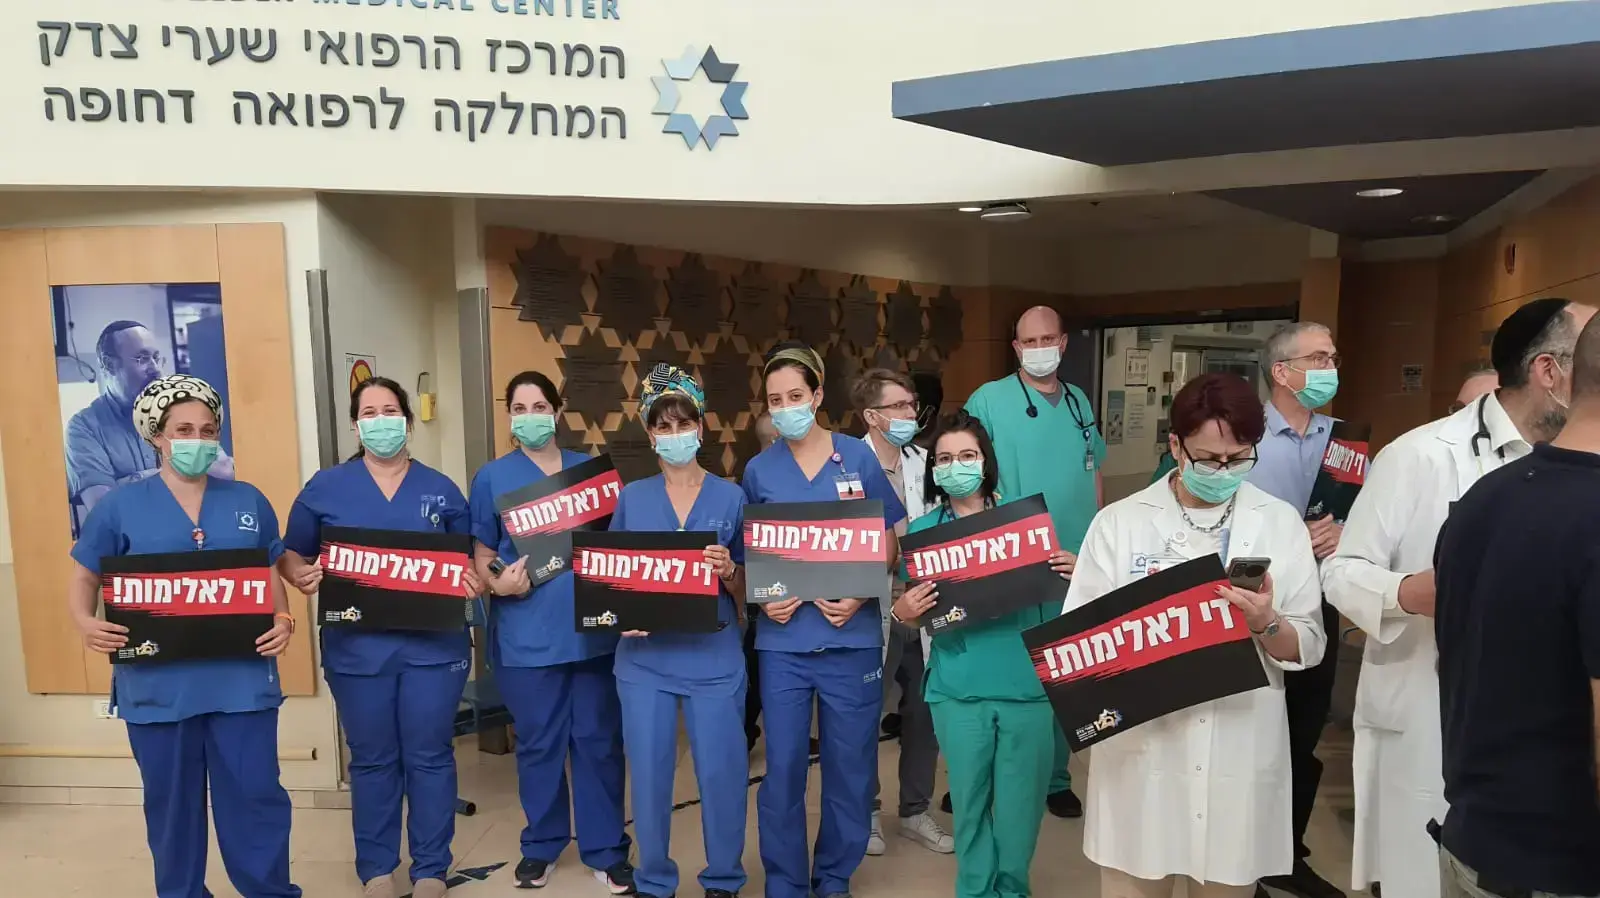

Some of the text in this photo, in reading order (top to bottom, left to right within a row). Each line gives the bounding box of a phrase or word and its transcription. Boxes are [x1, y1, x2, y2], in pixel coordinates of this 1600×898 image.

[36, 20, 626, 79] המרכז הרפואי שערי צדק
[43, 86, 627, 142] המחלקה לרפואה דחופה
[509, 487, 600, 533] לאלימות!
[751, 522, 881, 553] די לאלימות!
[912, 526, 1051, 577] די לאלימות!
[327, 545, 464, 588] די לאלימות!
[581, 550, 686, 583] לאלימות!
[692, 561, 714, 586] די
[112, 576, 266, 604] די לאלימות!
[1043, 597, 1235, 679] די לאלימות!
